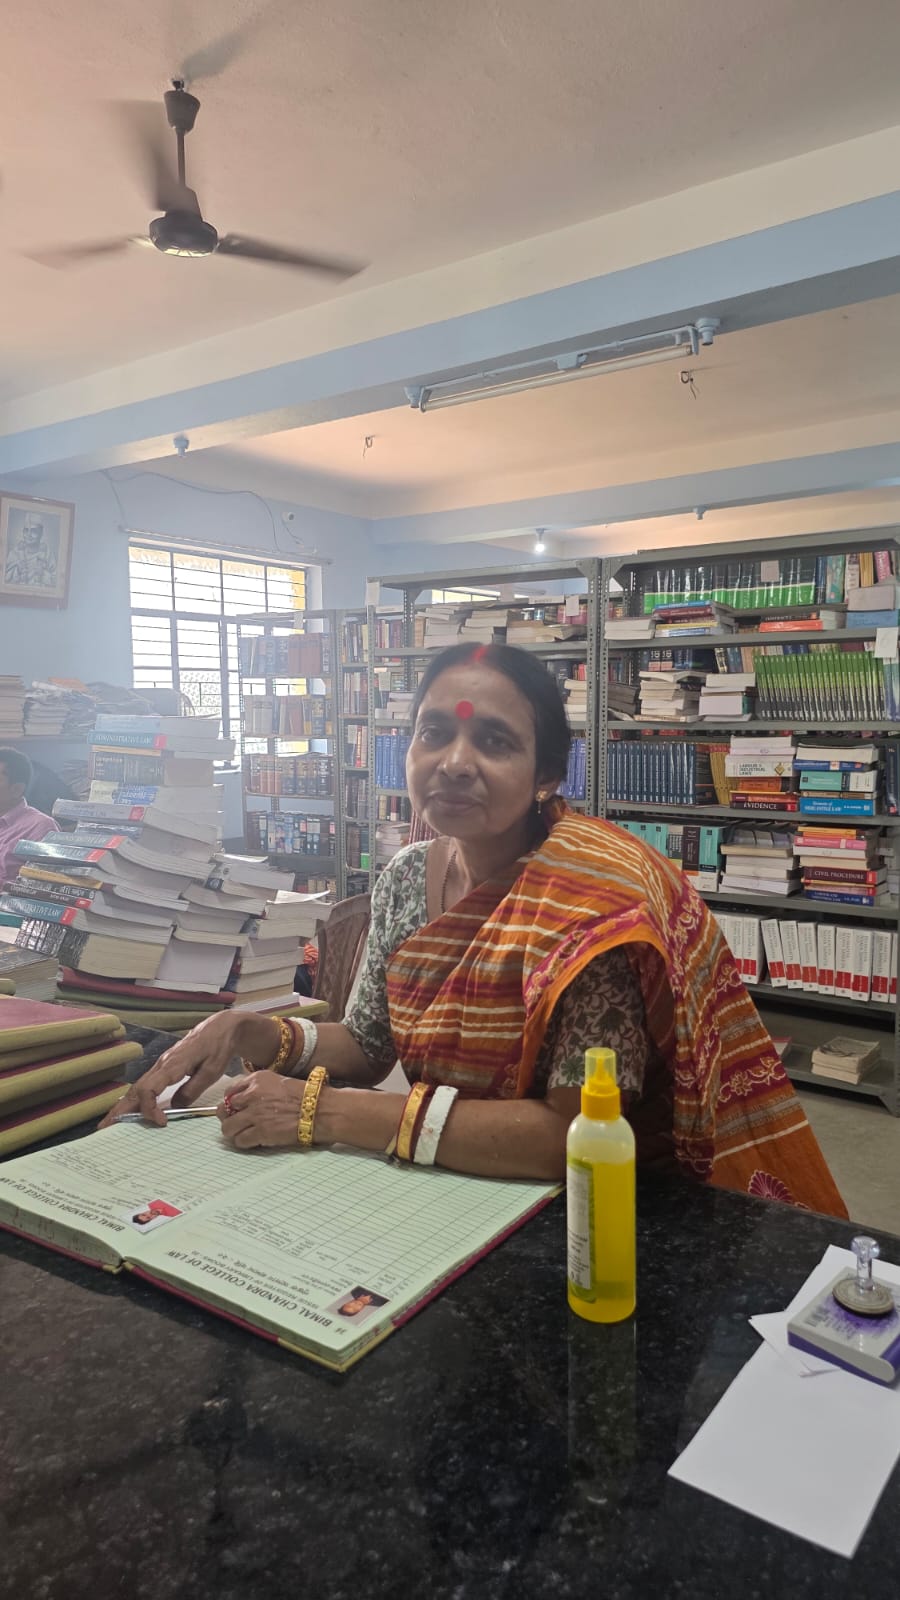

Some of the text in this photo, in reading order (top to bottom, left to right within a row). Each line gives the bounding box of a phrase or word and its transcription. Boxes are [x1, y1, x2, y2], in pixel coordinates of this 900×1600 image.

[743, 802, 777, 810] EVIDENCE
[830, 871, 865, 880] PROCEDURE
[167, 1249, 188, 1262] LAW
[184, 1255, 202, 1268] OF
[198, 1262, 246, 1287] COLLEGE
[244, 1283, 298, 1311] CHANDRA
[297, 1307, 333, 1327] BIMAL
